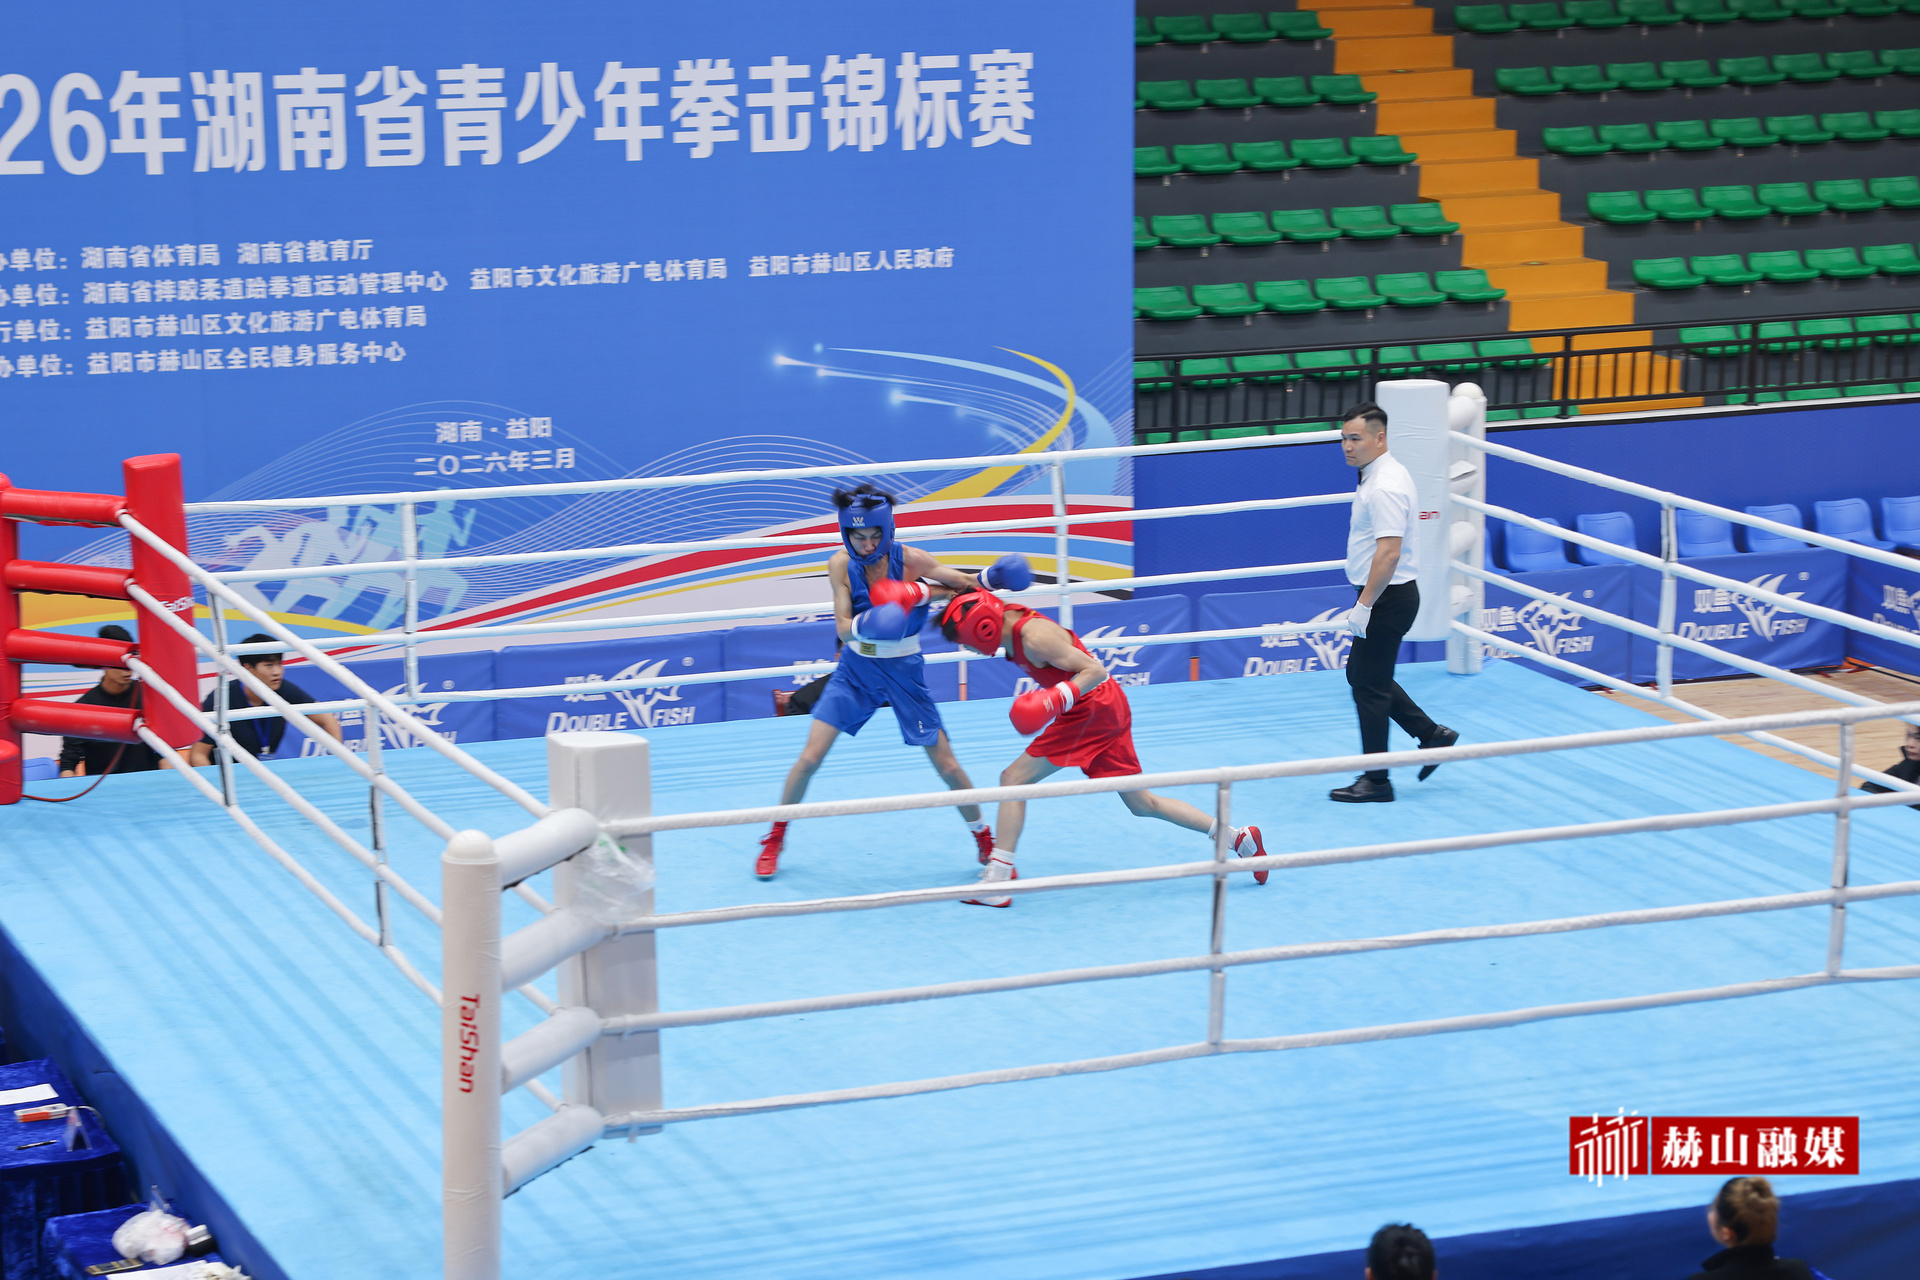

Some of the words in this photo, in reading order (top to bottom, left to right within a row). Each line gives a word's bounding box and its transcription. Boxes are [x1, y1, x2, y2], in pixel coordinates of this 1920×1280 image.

[0, 49, 1034, 175] 26年湖南省青少年拳击锦标赛
[237, 239, 373, 265] 湖南省教育厅
[470, 258, 727, 290] 益阳市文化旅游广电体育局
[748, 247, 955, 277] 益阳市赫山区人民政府
[1678, 622, 1750, 641] DOUBLE
[1770, 618, 1809, 636] FISH
[1556, 636, 1594, 654] FISH
[1243, 657, 1319, 677] DOUBLE
[546, 712, 628, 736] DOUBLE
[653, 706, 696, 726] FISH
[459, 994, 481, 1093] TaiShan
